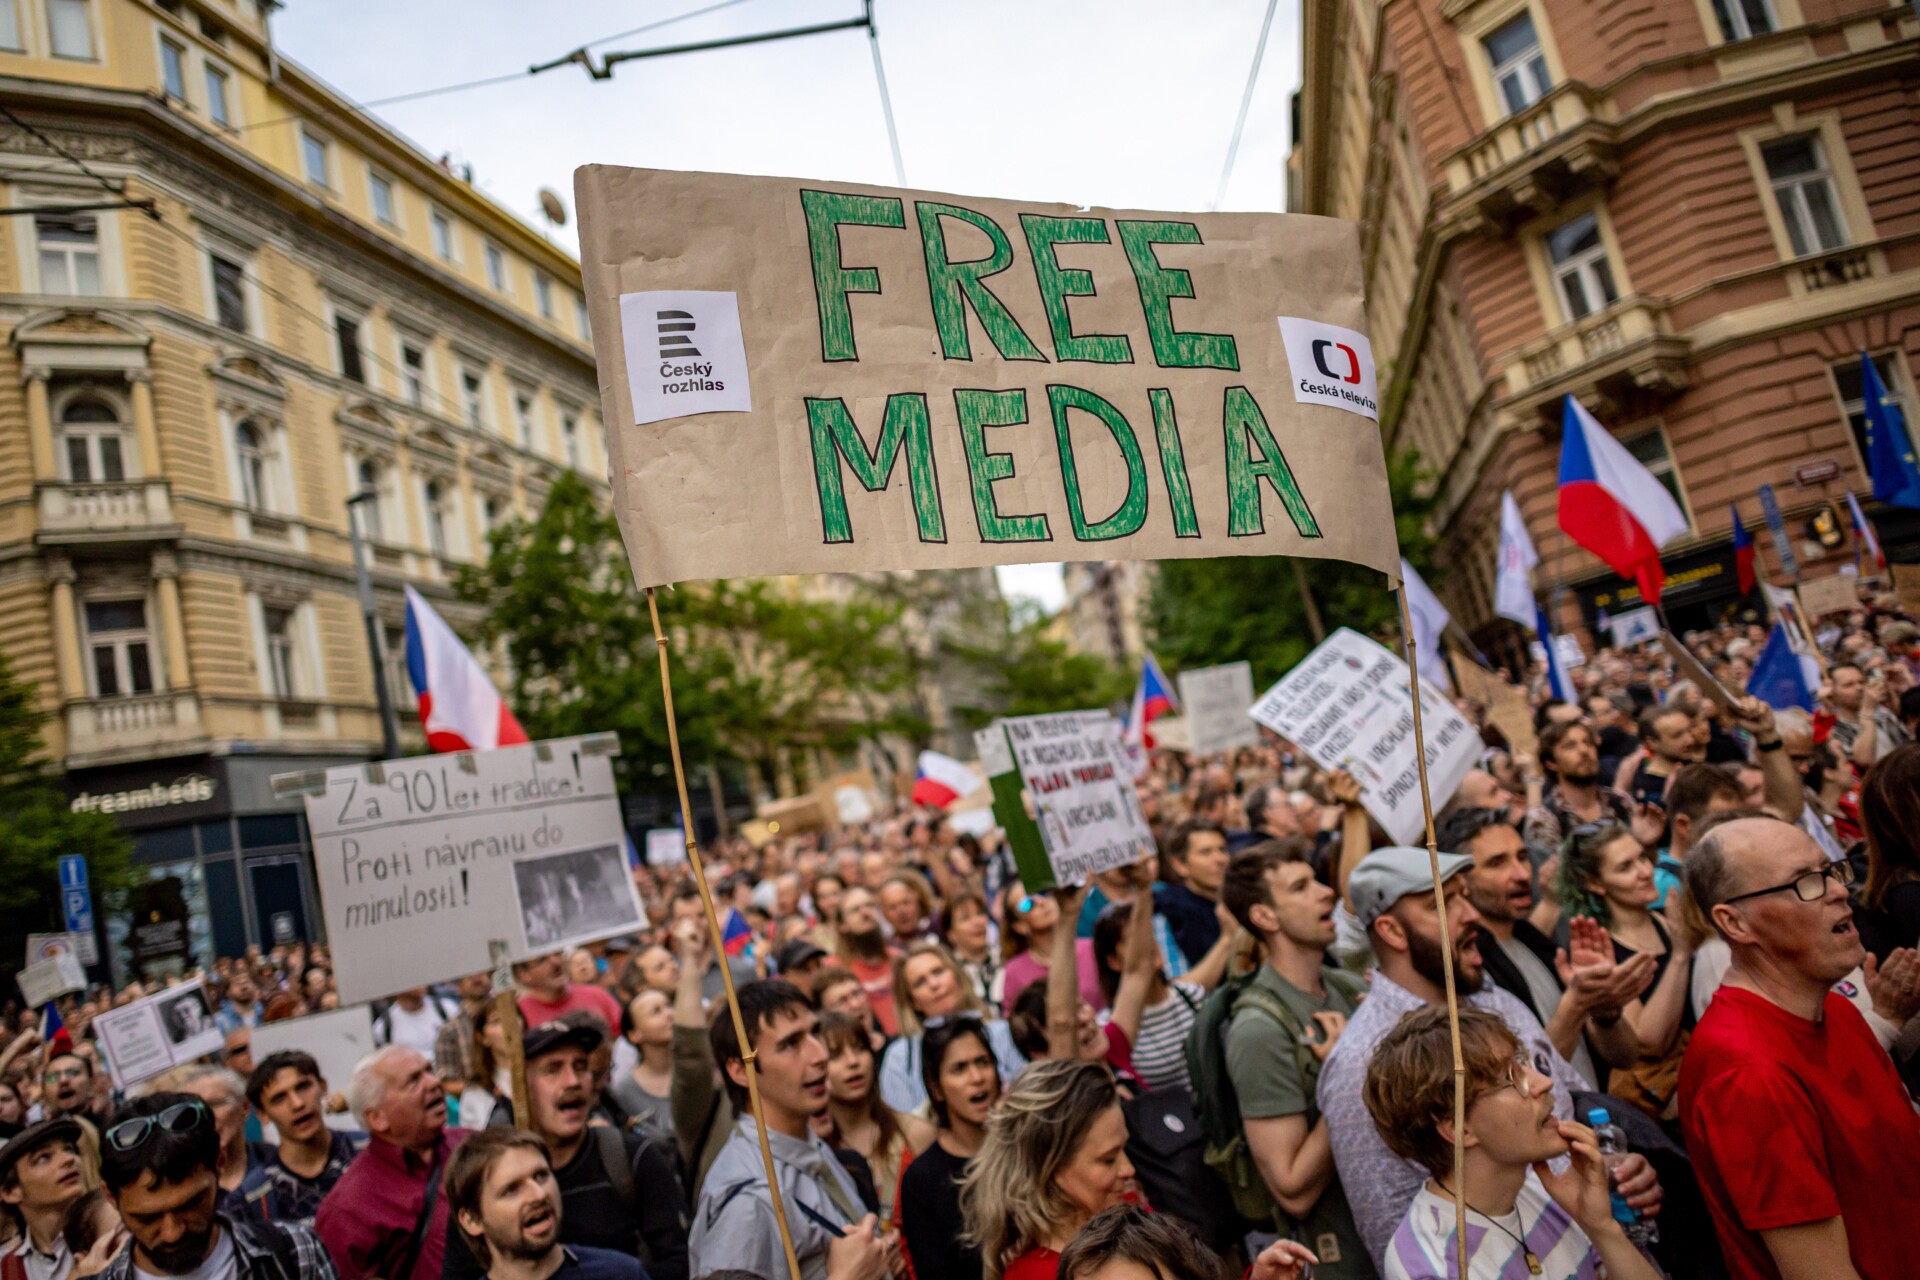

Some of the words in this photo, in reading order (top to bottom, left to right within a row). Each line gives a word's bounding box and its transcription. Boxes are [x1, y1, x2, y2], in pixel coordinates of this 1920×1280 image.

[800, 189, 1241, 371] FREE
[660, 361, 713, 378] Český
[662, 378, 725, 394] rozhlas
[1300, 379, 1340, 397] Česká
[1340, 388, 1377, 412] televize
[803, 384, 1323, 544] MEDIA
[71, 774, 215, 814] dreambeds
[329, 776, 382, 825] Za
[388, 769, 435, 814] 90
[442, 766, 480, 809] let
[489, 752, 584, 806] tradice!
[341, 838, 411, 885] Proti
[532, 814, 564, 851] do
[69, 892, 84, 914] P
[345, 869, 470, 929] minulosti!
